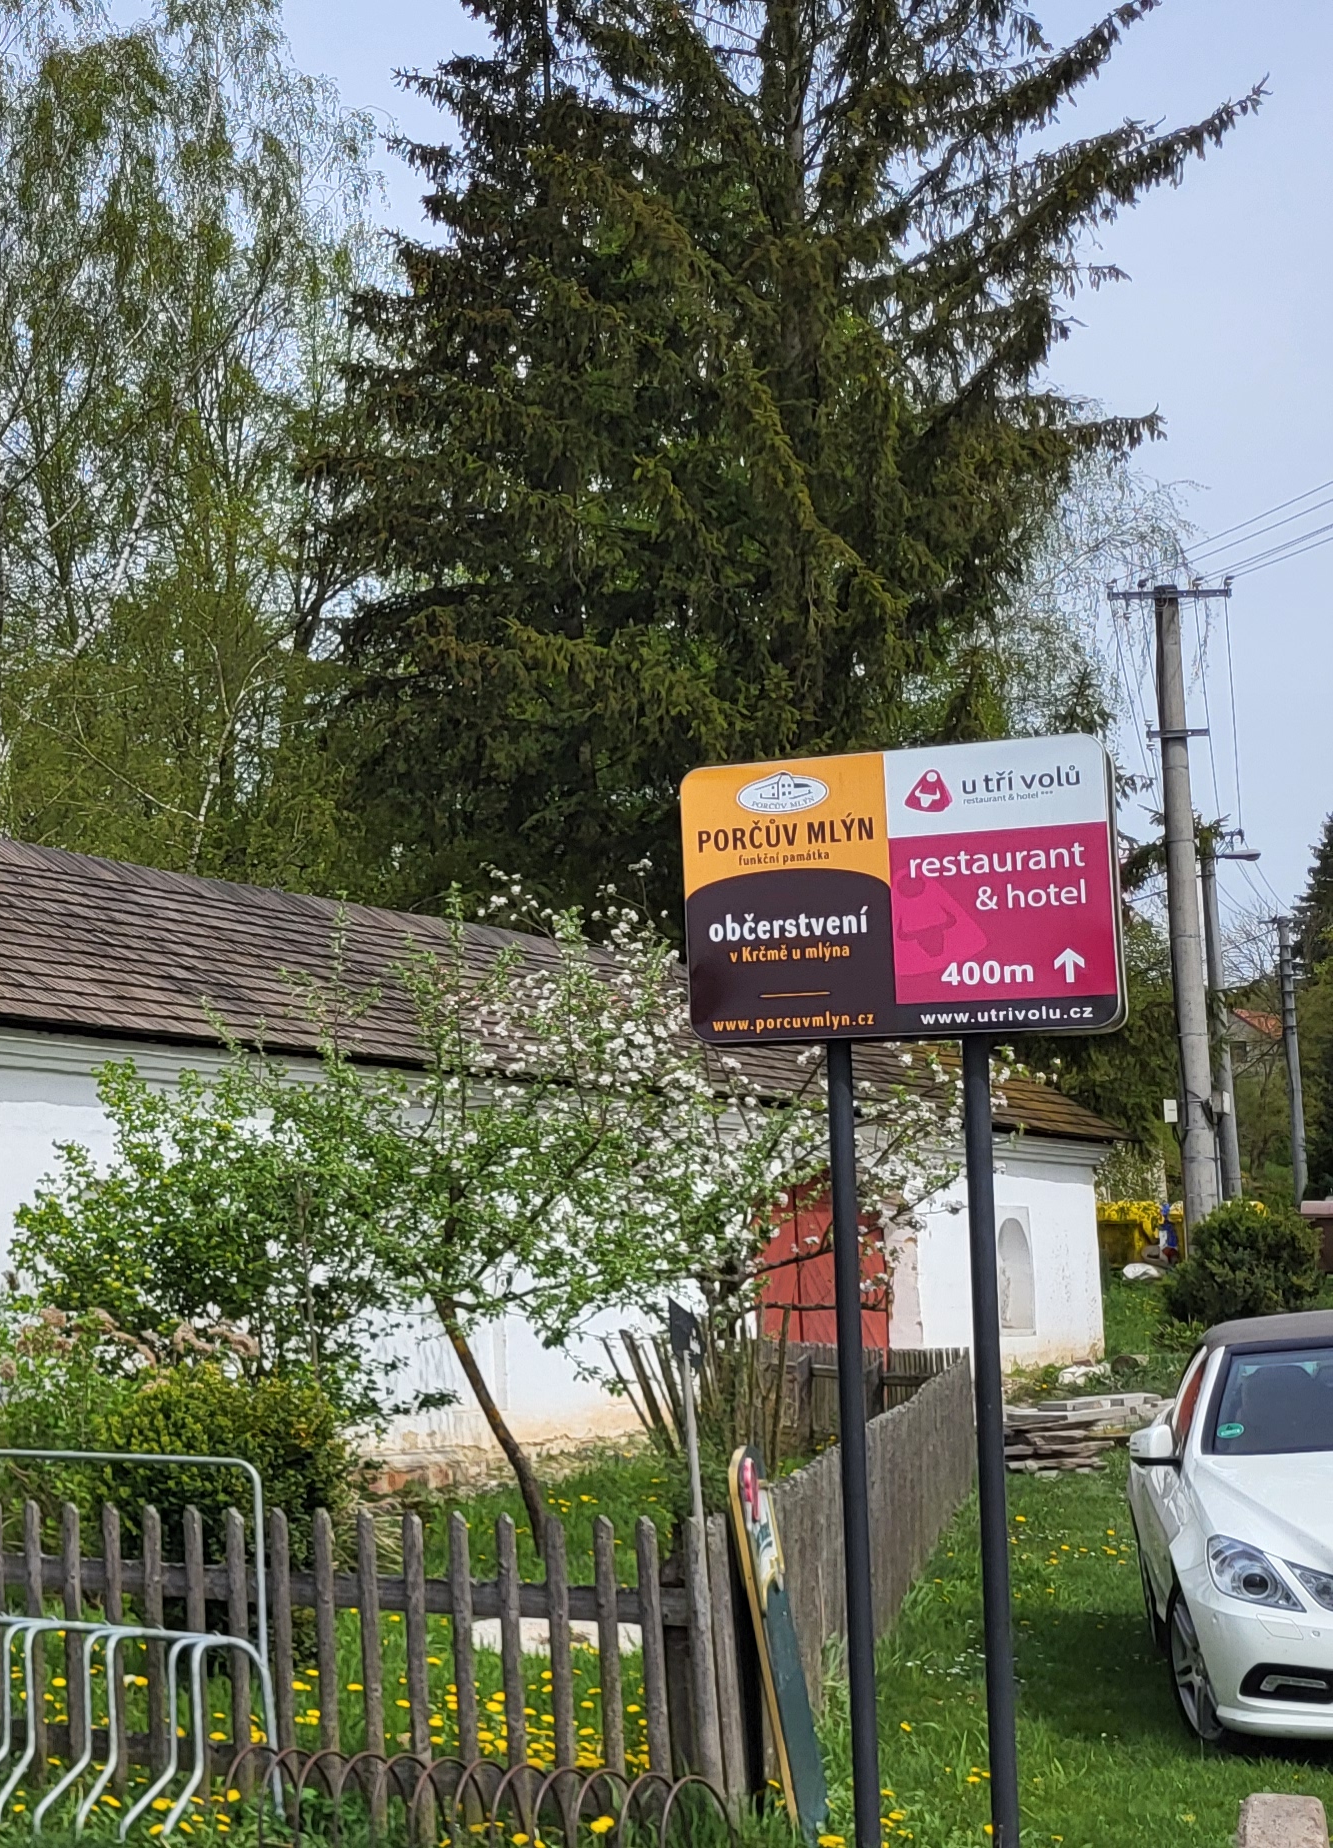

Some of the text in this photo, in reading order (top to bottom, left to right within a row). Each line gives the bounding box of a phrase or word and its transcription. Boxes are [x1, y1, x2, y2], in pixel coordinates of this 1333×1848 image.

[962, 764, 1080, 794] u tří volů
[963, 794, 1006, 804] restaurant
[1016, 791, 1038, 800] hotel
[698, 812, 874, 853] PORČŮV MLÝN
[739, 849, 829, 866] funkční památka
[909, 842, 1085, 878] restaurant
[975, 878, 1086, 910] & hotel
[709, 906, 868, 942] občerstvení
[730, 942, 850, 962] v Krčmě u mlýna
[941, 960, 1033, 985] 400m
[712, 1012, 874, 1033] www.porcuvmlyn.cz
[920, 1005, 1093, 1024] www.utrivolu.cz
